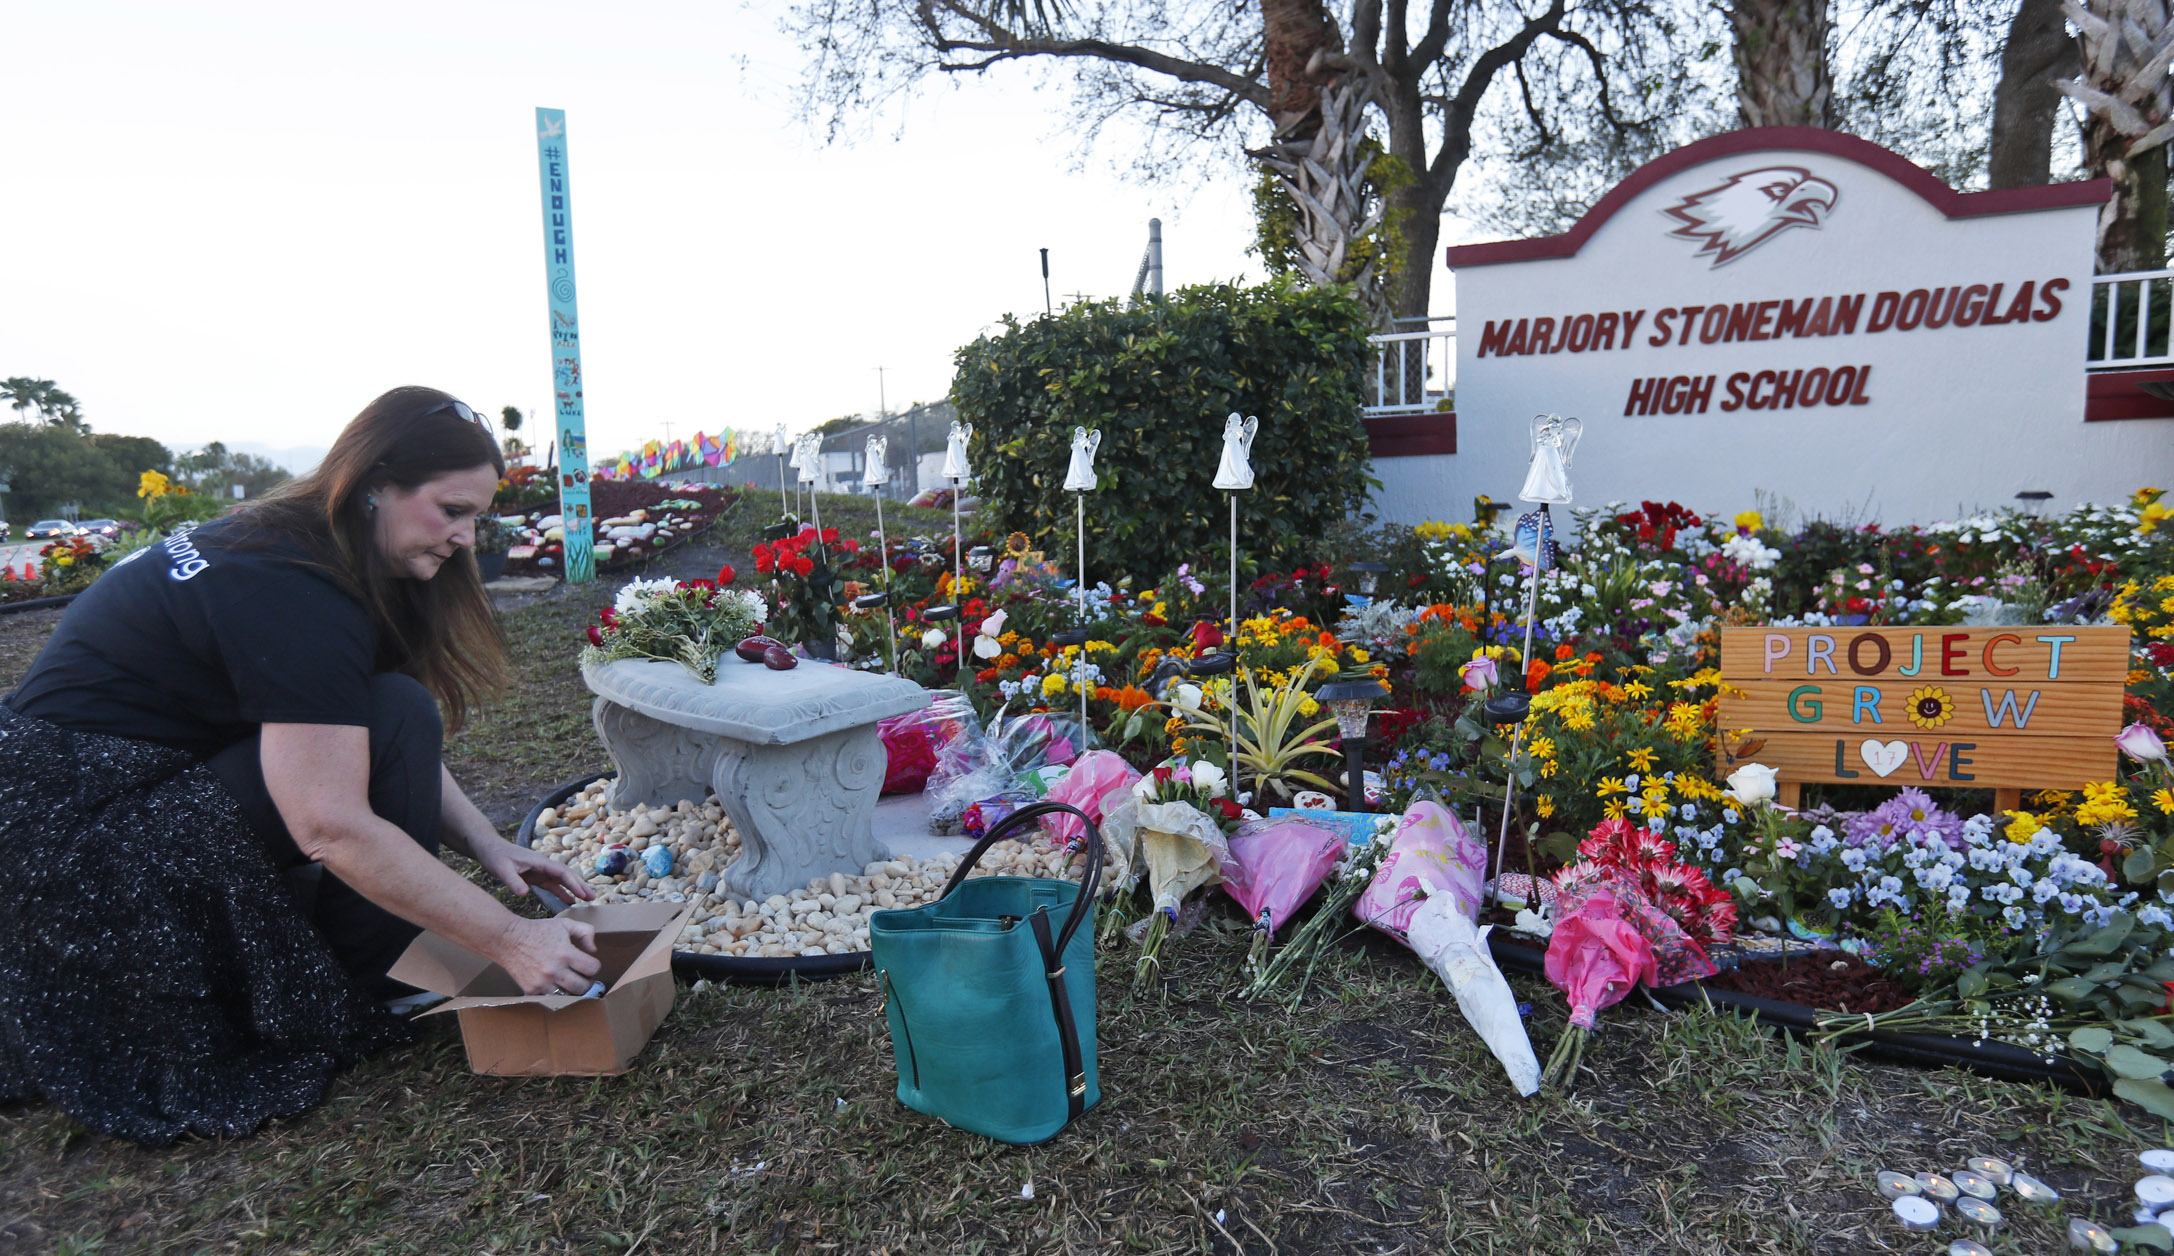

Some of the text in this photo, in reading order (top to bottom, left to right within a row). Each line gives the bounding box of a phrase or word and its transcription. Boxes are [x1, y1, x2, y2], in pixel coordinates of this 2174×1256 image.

[545, 145, 568, 265] #ENOUGH
[1477, 278, 2070, 358] MARJORY STONEMAN DOUGLAS
[1624, 365, 1873, 416] HIGH SCHOOL
[1763, 632, 2076, 679] PROJECT
